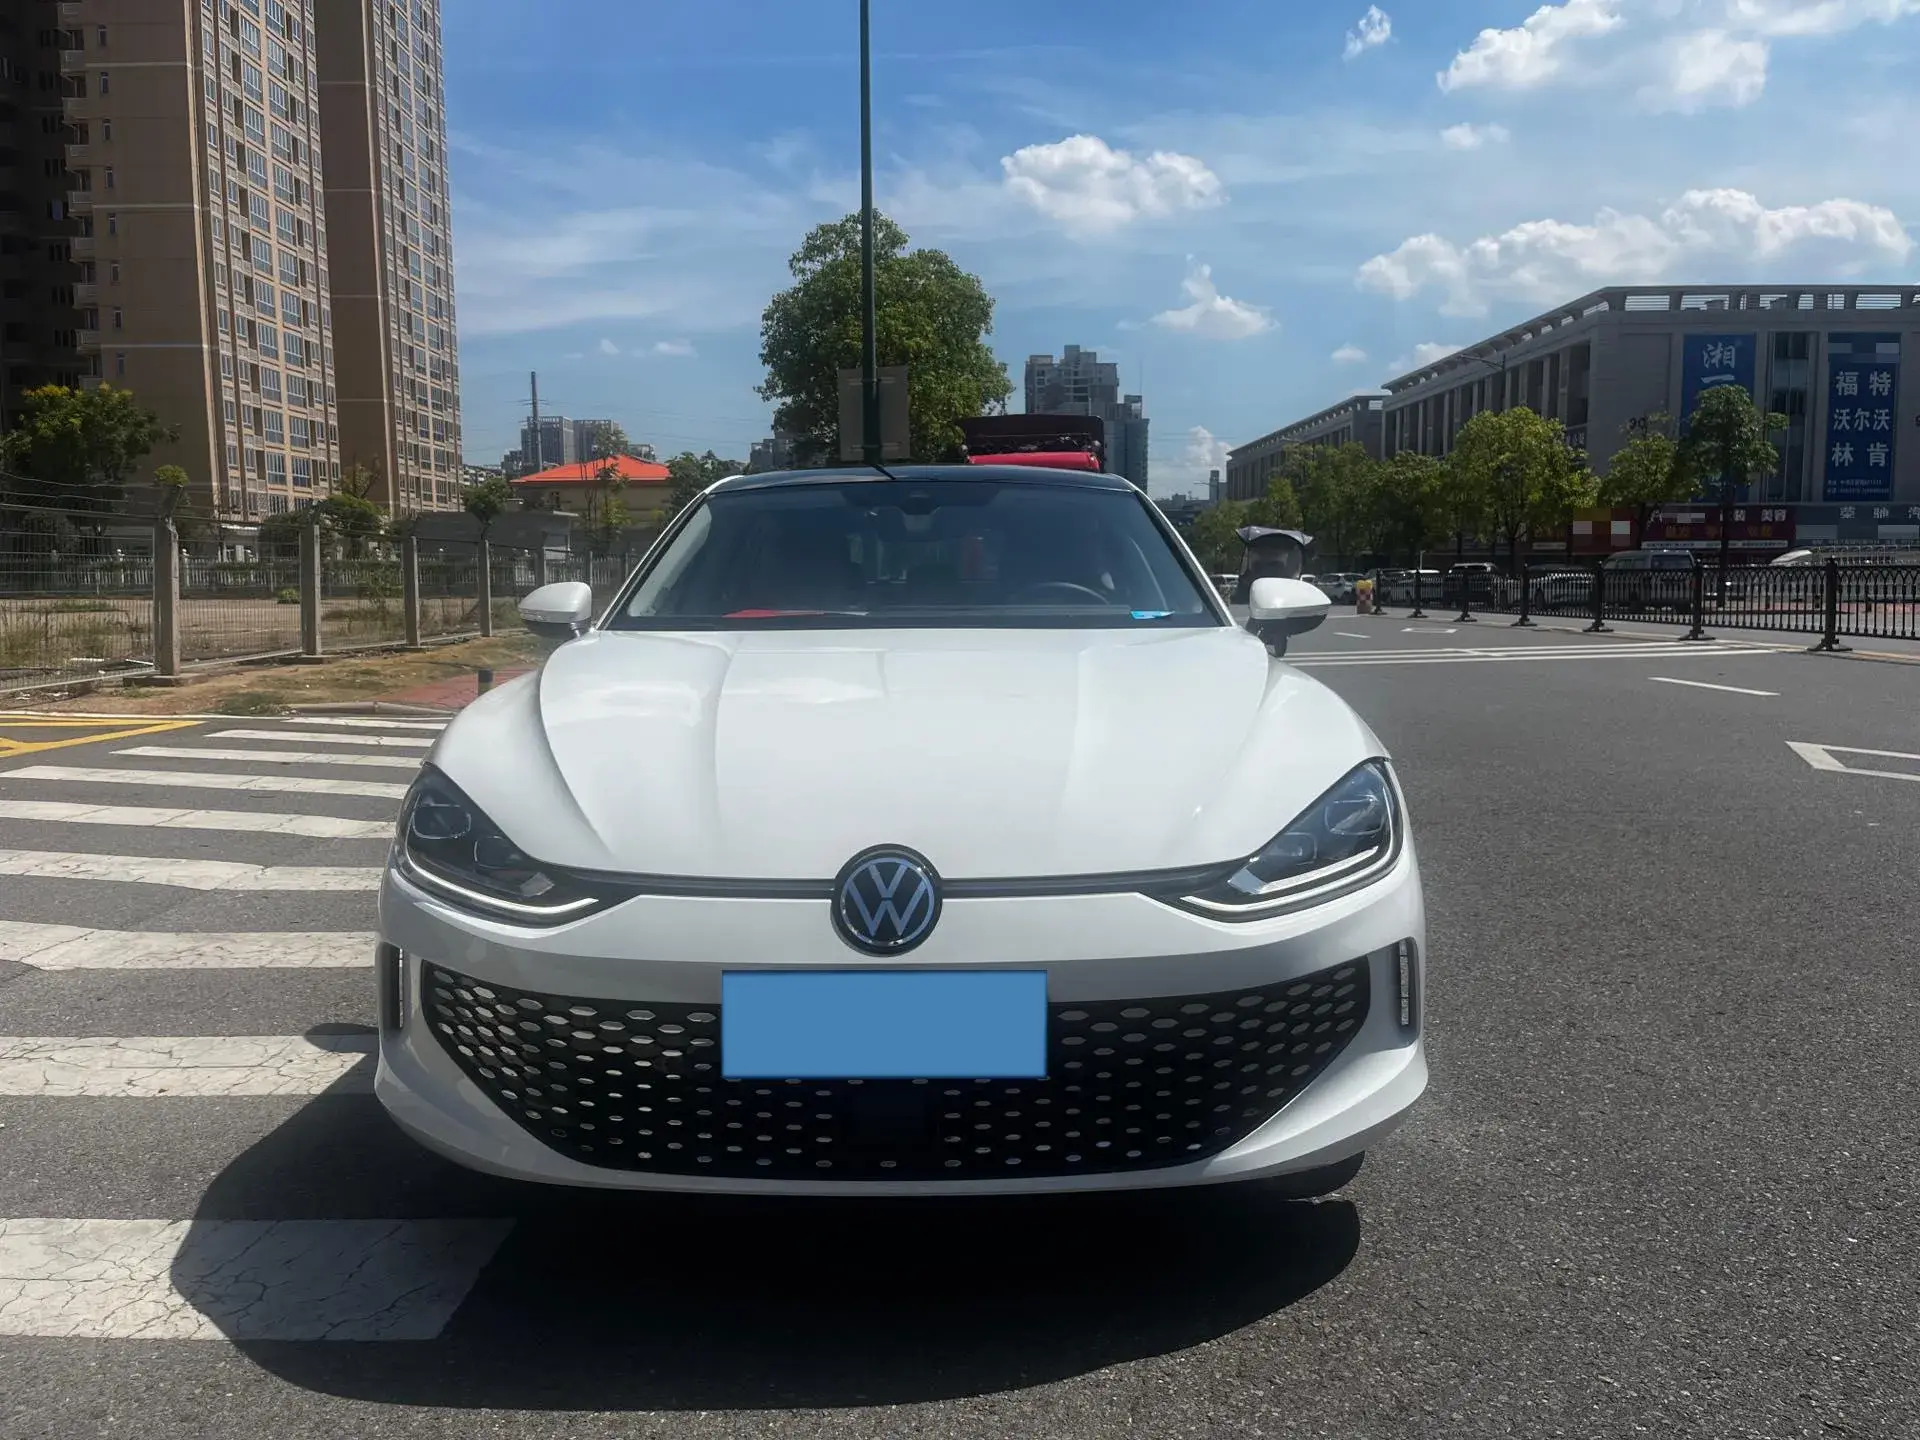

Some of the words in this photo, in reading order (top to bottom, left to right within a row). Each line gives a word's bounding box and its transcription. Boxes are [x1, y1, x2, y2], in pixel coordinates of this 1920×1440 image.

[1836, 371, 1892, 396] 福特
[1833, 408, 1891, 431] 沃尔沃
[1831, 442, 1889, 467] 林肯
